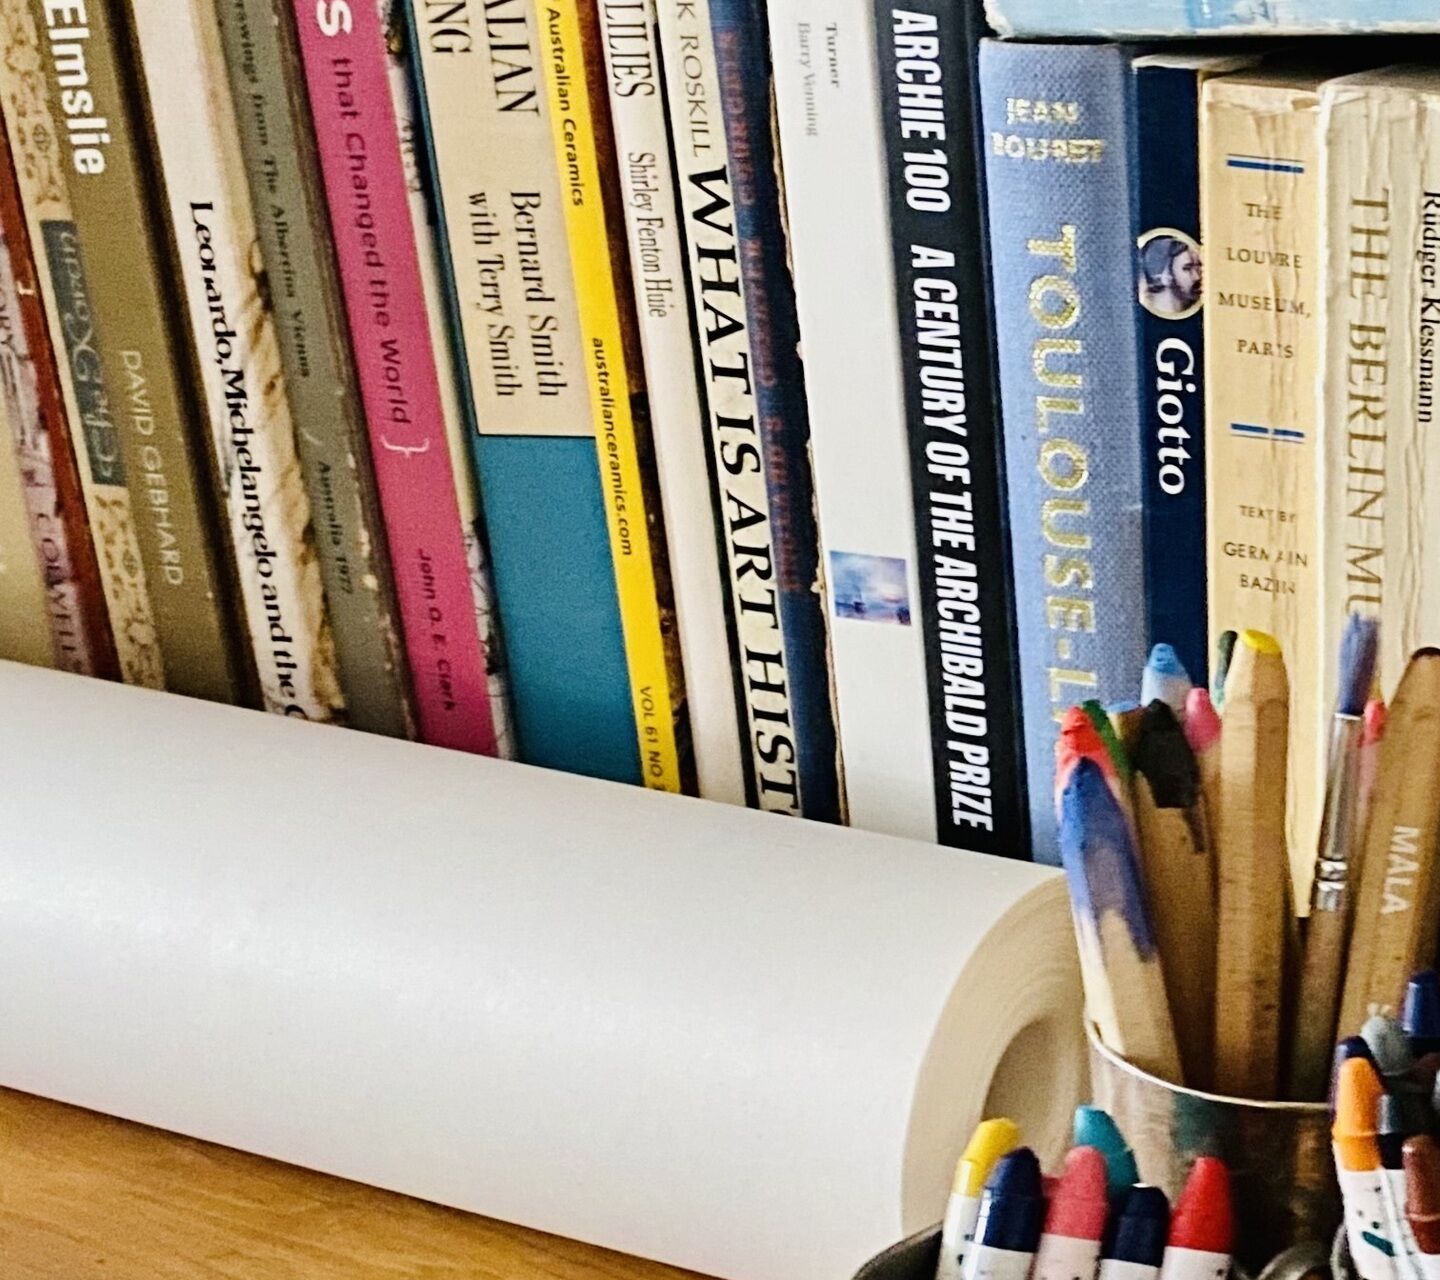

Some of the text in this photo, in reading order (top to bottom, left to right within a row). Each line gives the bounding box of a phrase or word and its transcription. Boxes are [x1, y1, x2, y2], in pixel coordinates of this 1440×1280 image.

[331, 57, 359, 121] that
[680, 34, 711, 158] ROSKILL
[797, 22, 813, 70] Barry
[826, 22, 842, 89] Turner
[546, 6, 574, 114] Australian
[563, 118, 586, 208] Ceramics
[252, 94, 269, 146] from
[264, 155, 280, 194] The
[292, 311, 310, 378] Vienna
[344, 131, 386, 269] Changed
[628, 152, 674, 319] Shirley Fenton Huie
[1245, 202, 1283, 220] THE
[1350, 188, 1391, 300] THE
[367, 278, 391, 328] the
[467, 191, 524, 398] with Terry Smith
[510, 190, 568, 398] Bernard Smith
[689, 165, 753, 396] WHAT
[1217, 291, 1312, 318] MUSEUM,
[1226, 246, 1304, 269] LOUVRE
[380, 338, 413, 425] World
[1236, 338, 1295, 359] PARIS
[591, 338, 633, 558] australianceramics.com
[715, 411, 762, 478] IS
[892, 8, 993, 832] ARCHIE 100 A CENTURY OF THE ARCHIBALD PRIZE
[1156, 337, 1196, 496] Giotto
[1346, 322, 1389, 521] BERLIN
[121, 350, 184, 586] DAVID GEBHARD
[221, 368, 278, 578] Michelangelo
[1026, 223, 1099, 723] TOULOUSE-L
[1239, 503, 1298, 523] TEXT BY
[418, 548, 437, 600] John
[725, 489, 781, 632] ART
[1222, 540, 1310, 568] GERMAIN
[1239, 572, 1297, 596] BAZIN
[261, 583, 294, 643] and
[273, 650, 298, 699] the
[640, 686, 655, 720] VOL
[648, 751, 664, 778] NO
[745, 644, 801, 816] HIST
[1380, 824, 1421, 917] MALA
